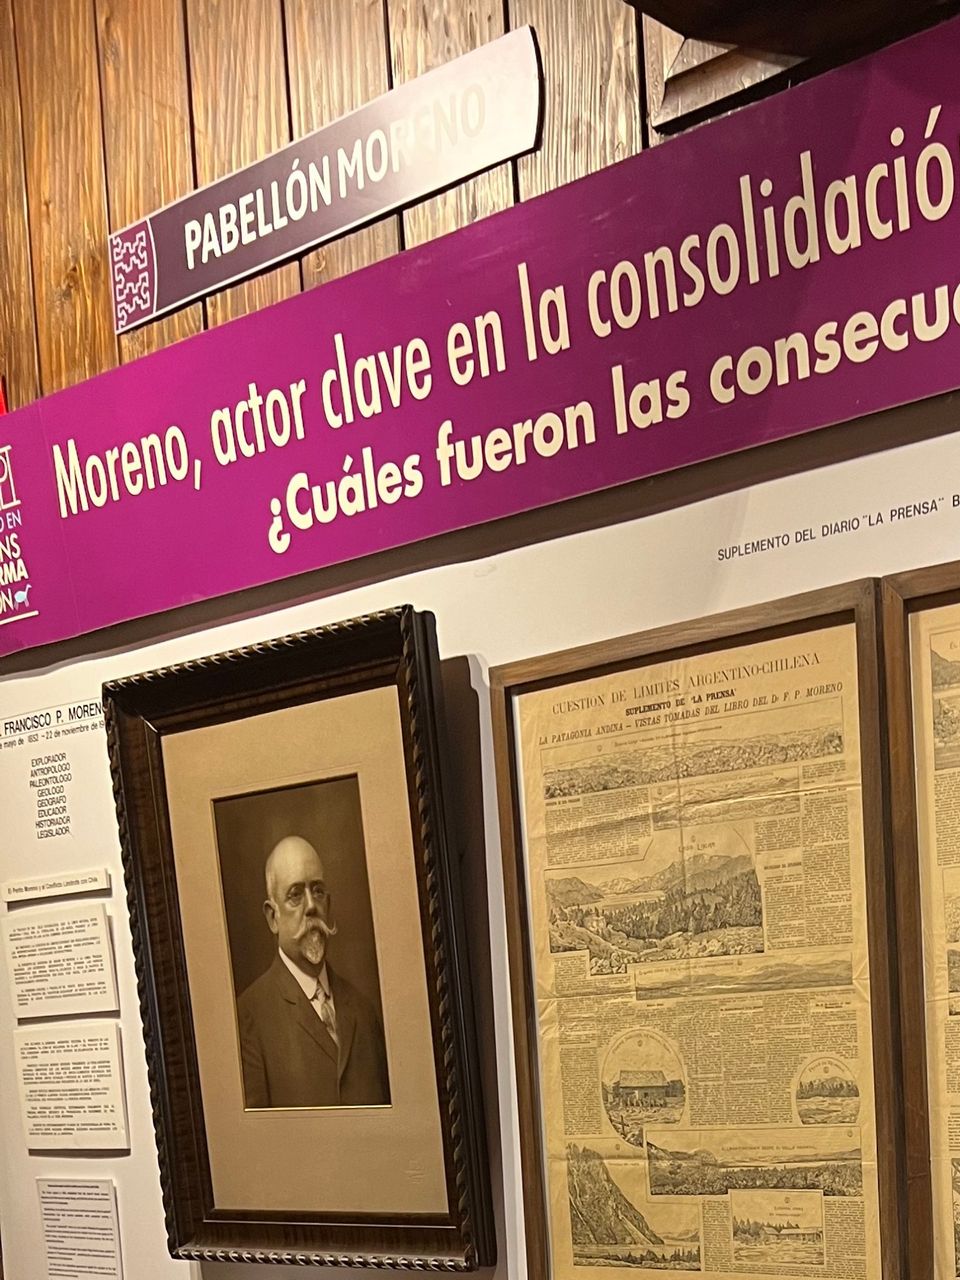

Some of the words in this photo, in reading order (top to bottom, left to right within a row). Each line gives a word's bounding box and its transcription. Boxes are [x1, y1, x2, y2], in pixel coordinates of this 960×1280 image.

[184, 154, 333, 270] PABELLÓN
[52, 425, 202, 519] Moreno,
[210, 373, 308, 466] actor
[321, 330, 435, 420] clave
[447, 304, 509, 387] en
[518, 261, 571, 362] la
[267, 444, 425, 556] ¿Cuáles
[437, 400, 597, 487] fueron
[611, 363, 690, 435] las
[718, 534, 789, 561] SUPLEMENTO
[795, 528, 816, 543] DEL
[822, 518, 859, 537] DIARIO
[553, 695, 604, 714] CUESTION
[612, 691, 626, 703] DE
[634, 680, 680, 699] LIMITES
[689, 653, 820, 688] ARGENTINO-CHILENA
[626, 701, 671, 716] SUPLEMENTO
[676, 698, 686, 707] DE
[4, 713, 51, 736] FRANCISCO
[56, 710, 64, 723] P.
[69, 702, 103, 720] MOREN
[539, 736, 548, 745] LA
[552, 729, 592, 743] PATAGONIA
[596, 724, 623, 734] ANDINA
[635, 716, 660, 728] VISTAS
[664, 709, 700, 722] TOMADAS
[705, 705, 720, 716] DEL
[724, 699, 748, 712] LIBRO
[753, 696, 768, 707] DEL
[807, 682, 842, 697] MORENO
[31, 753, 66, 767] EXPLORADOR
[38, 826, 69, 839] LEGISLADOR
